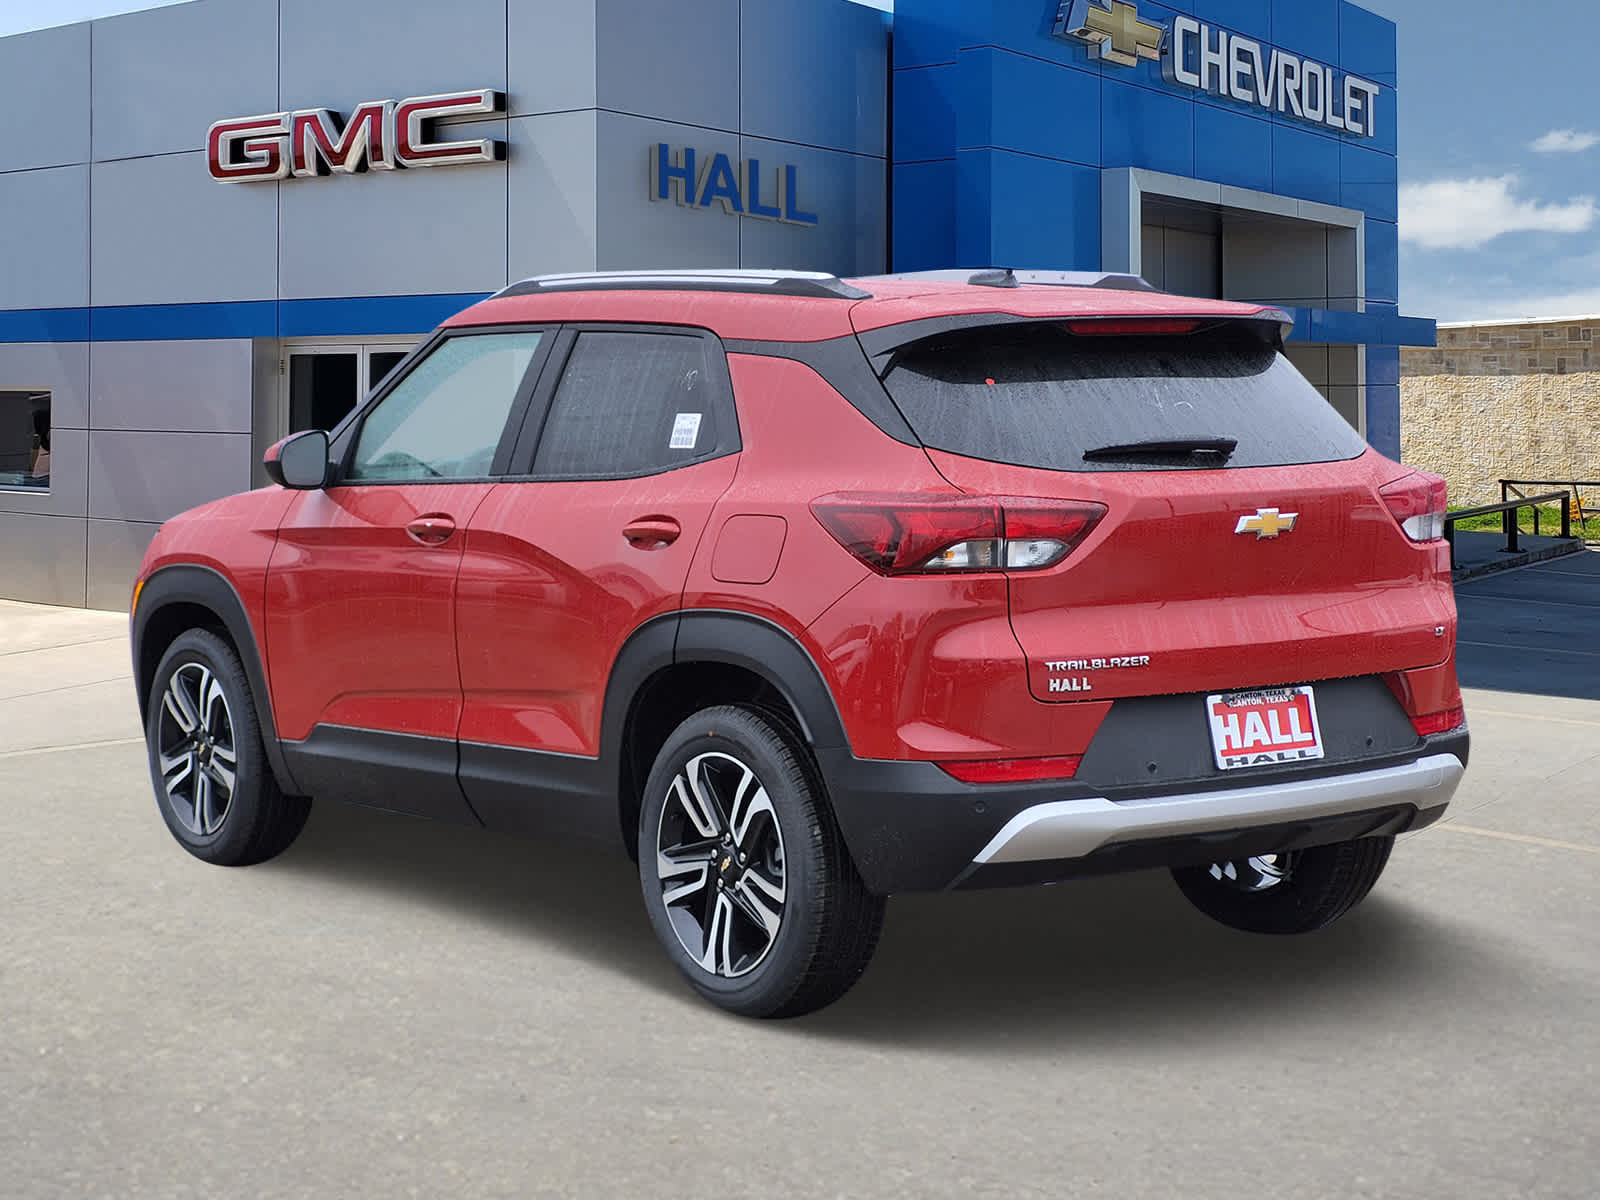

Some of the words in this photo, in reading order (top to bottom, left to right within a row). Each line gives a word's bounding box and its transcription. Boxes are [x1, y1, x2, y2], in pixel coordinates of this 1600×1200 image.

[1173, 15, 1380, 137] CHEVROLET
[208, 88, 505, 183] GMC
[652, 143, 818, 227] HALL
[1045, 655, 1150, 672] TRAILBLAZER
[1048, 677, 1092, 692] HALL
[1265, 689, 1286, 697] TEXAS
[1265, 694, 1289, 704] TEXAS
[1213, 707, 1314, 751] HALL
[1225, 750, 1318, 767] HALL
